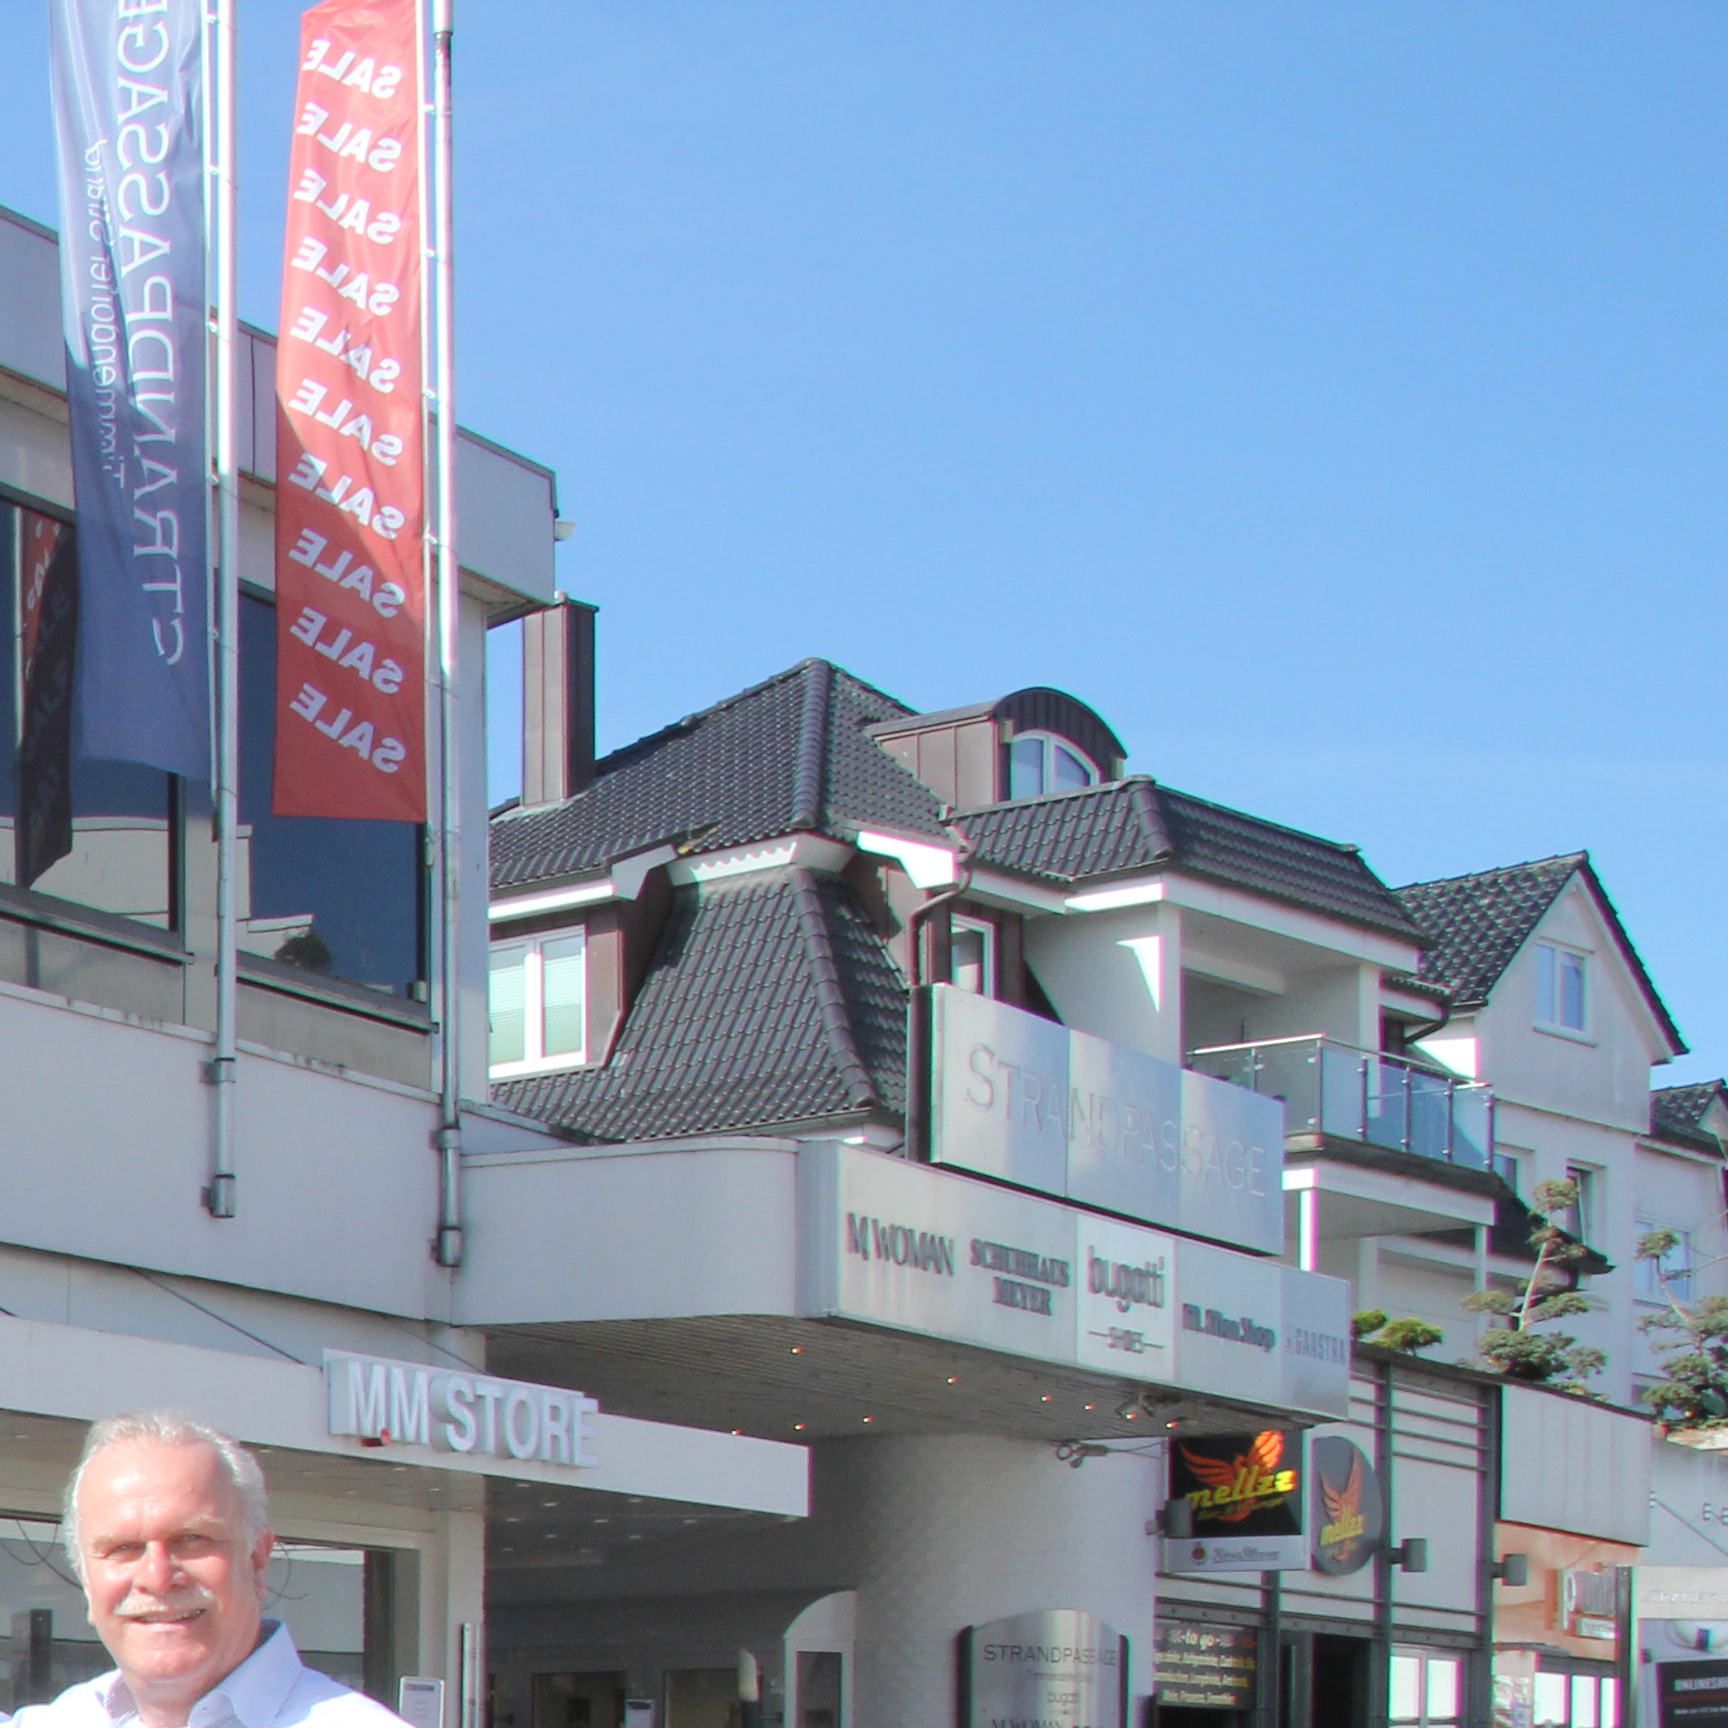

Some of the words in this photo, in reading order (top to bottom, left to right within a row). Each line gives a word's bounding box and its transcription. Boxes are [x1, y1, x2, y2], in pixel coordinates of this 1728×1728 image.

[965, 1042, 1266, 1198] STRANDPASSAGE
[1088, 1245, 1165, 1313] bugatti
[347, 1361, 431, 1446] MM
[445, 1375, 599, 1468] STORE
[1185, 1466, 1298, 1510] mellzz
